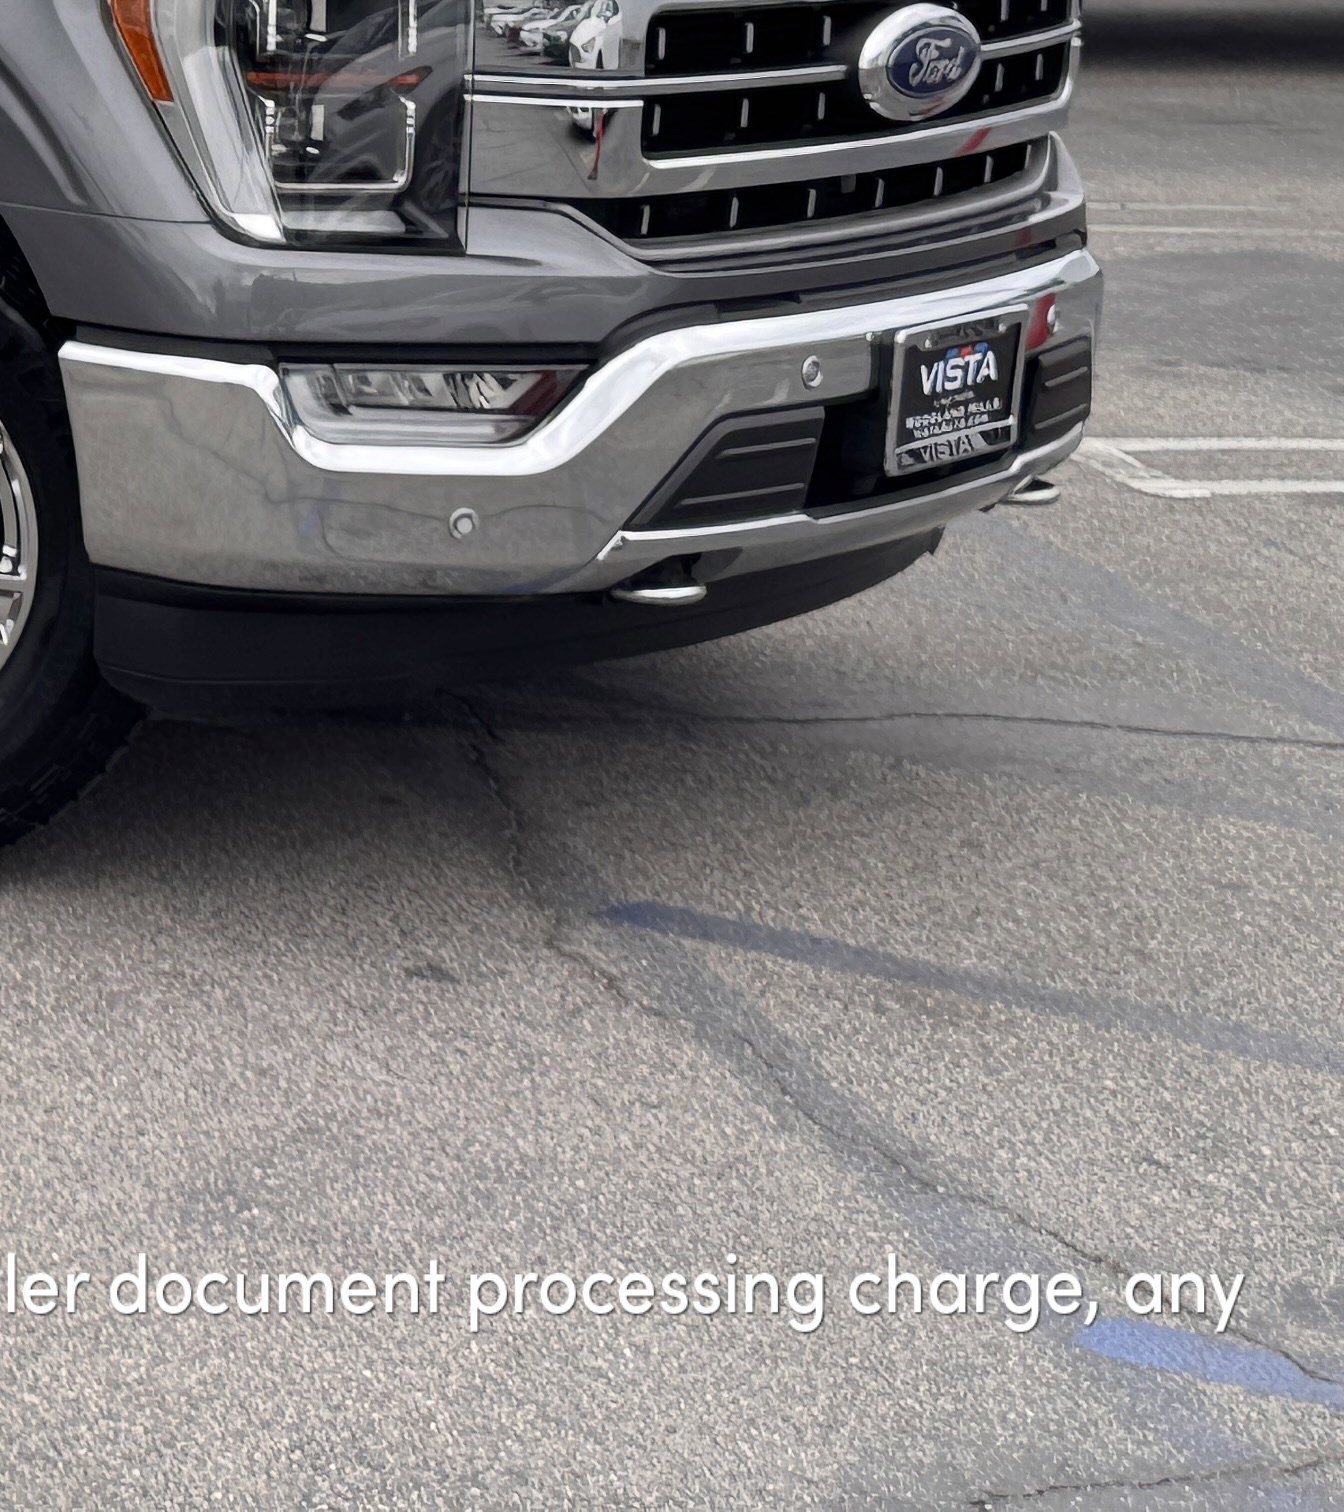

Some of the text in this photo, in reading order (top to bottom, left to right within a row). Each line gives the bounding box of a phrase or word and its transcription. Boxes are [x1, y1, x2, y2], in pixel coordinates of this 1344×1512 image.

[908, 37, 964, 88] Ford
[920, 350, 999, 396] VISTA
[921, 434, 975, 463] VISTA
